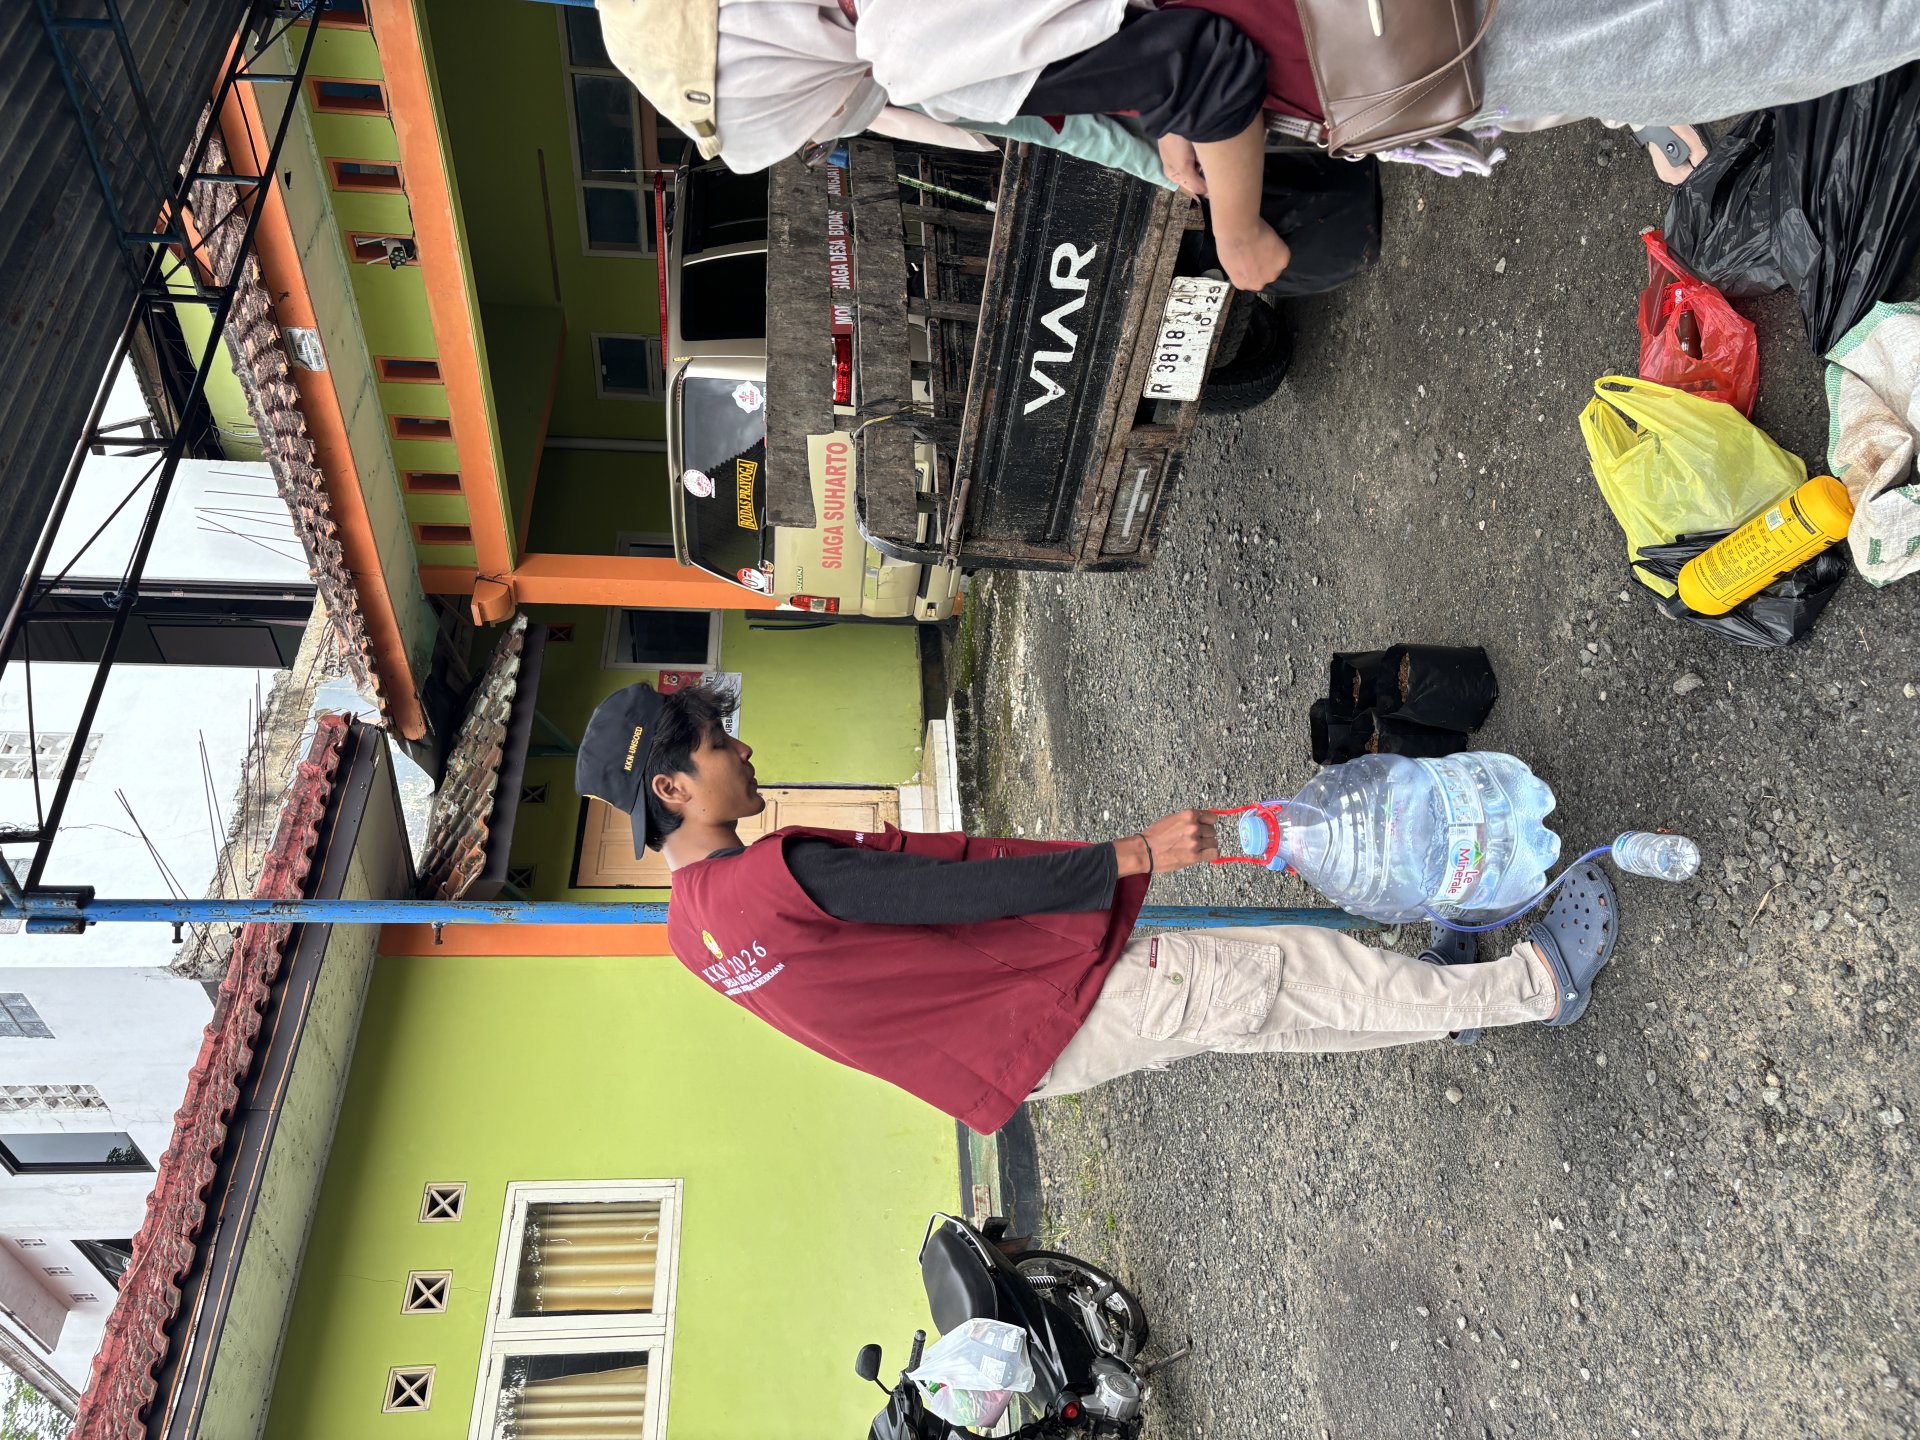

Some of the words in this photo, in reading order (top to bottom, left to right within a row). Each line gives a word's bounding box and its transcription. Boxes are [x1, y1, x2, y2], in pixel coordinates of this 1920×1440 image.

[827, 165, 842, 196] ANGJATI
[828, 210, 844, 236] BODAS
[828, 240, 848, 262] DESA
[1022, 242, 1098, 416] VIAR
[1156, 330, 1185, 374] 3818
[1150, 384, 1172, 394] R
[738, 461, 756, 499] PRAYOGA
[823, 442, 848, 520] SUHARTO
[738, 500, 755, 527] BODAS
[821, 526, 844, 569] SIAGA
[796, 566, 804, 592] SUZUKI
[623, 726, 643, 771] KKN-UNSOED
[1447, 848, 1471, 894] Minerale
[1463, 870, 1478, 884] Le
[702, 962, 730, 983] KKN
[726, 940, 766, 974] 2026
